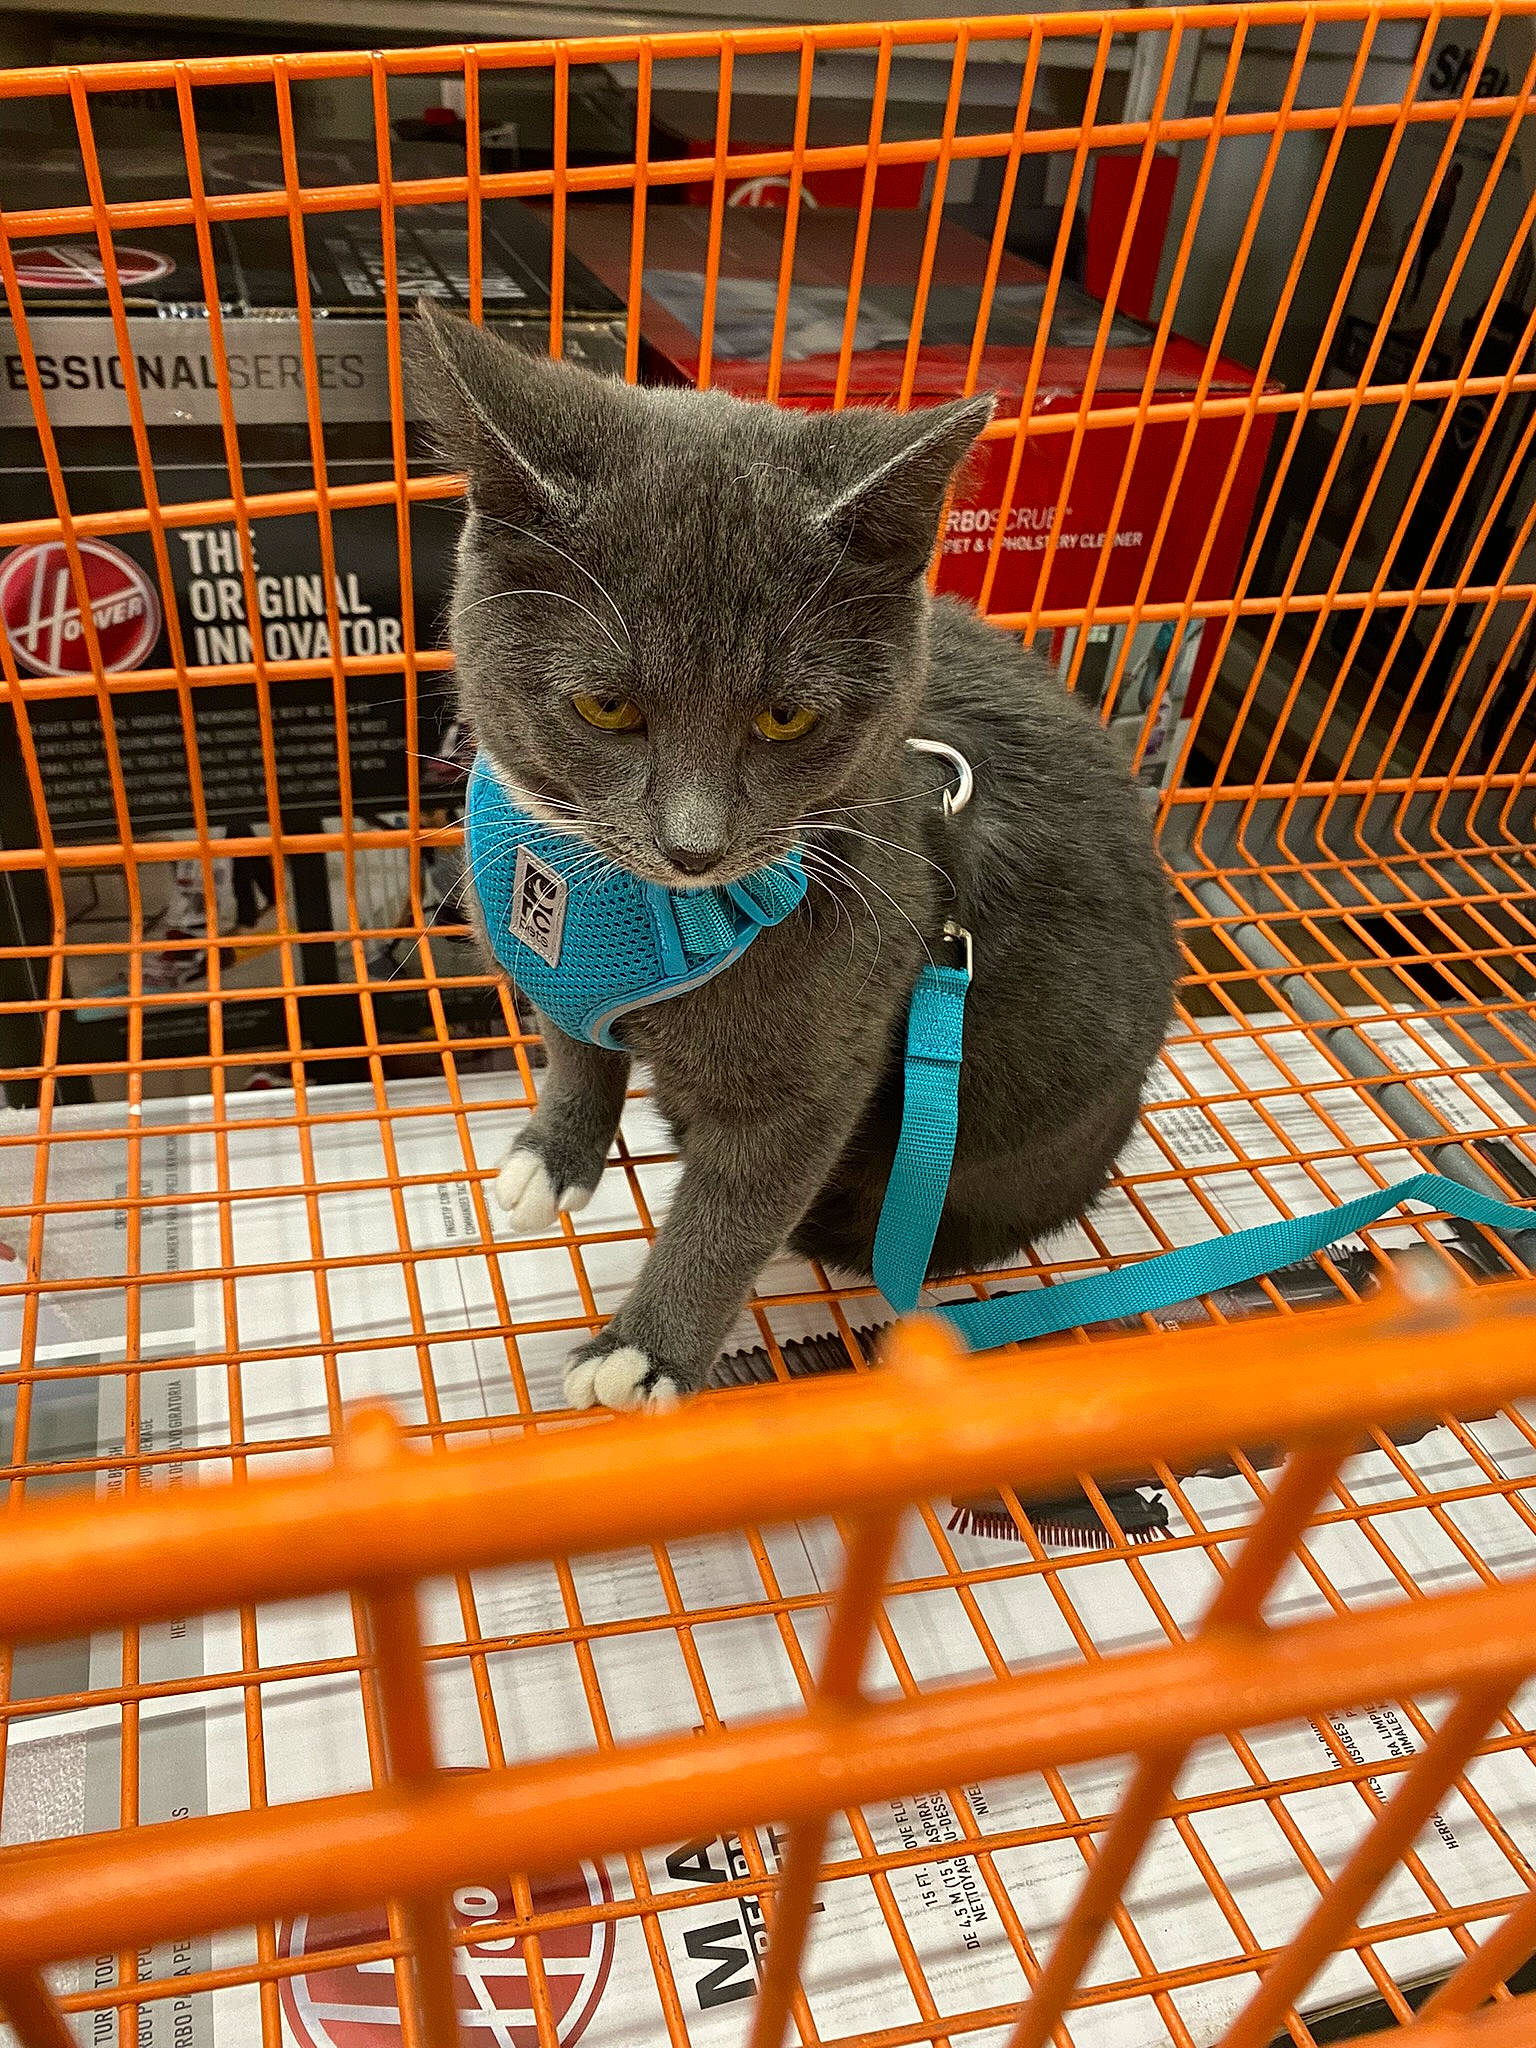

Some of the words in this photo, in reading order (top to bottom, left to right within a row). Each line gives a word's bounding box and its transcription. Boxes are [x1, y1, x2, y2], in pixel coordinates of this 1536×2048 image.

[943, 537, 971, 555] PET
[972, 537, 986, 553] &
[1080, 531, 1144, 549] CLENER
[189, 572, 372, 622] ORGINAL
[438, 1184, 450, 1205] CONTR
[1364, 1705, 1393, 1740] LIMPIE
[1383, 1711, 1417, 1755] NIMALES
[1334, 1722, 1365, 1765] USAGES
[1387, 1742, 1403, 1757] RA
[891, 1800, 909, 1824] FLO
[914, 1794, 942, 1844] ASPIRAT
[900, 1825, 918, 1849] OVE
[1430, 1811, 1460, 1850] HERRA
[915, 1867, 932, 1887] FT.
[954, 1857, 988, 1922] NETTOYAG
[922, 1890, 938, 1908] 15
[949, 1892, 964, 1905] M
[963, 1931, 981, 1950] DE
[94, 1953, 113, 1988] TOO
[94, 2008, 113, 2046] TUR
